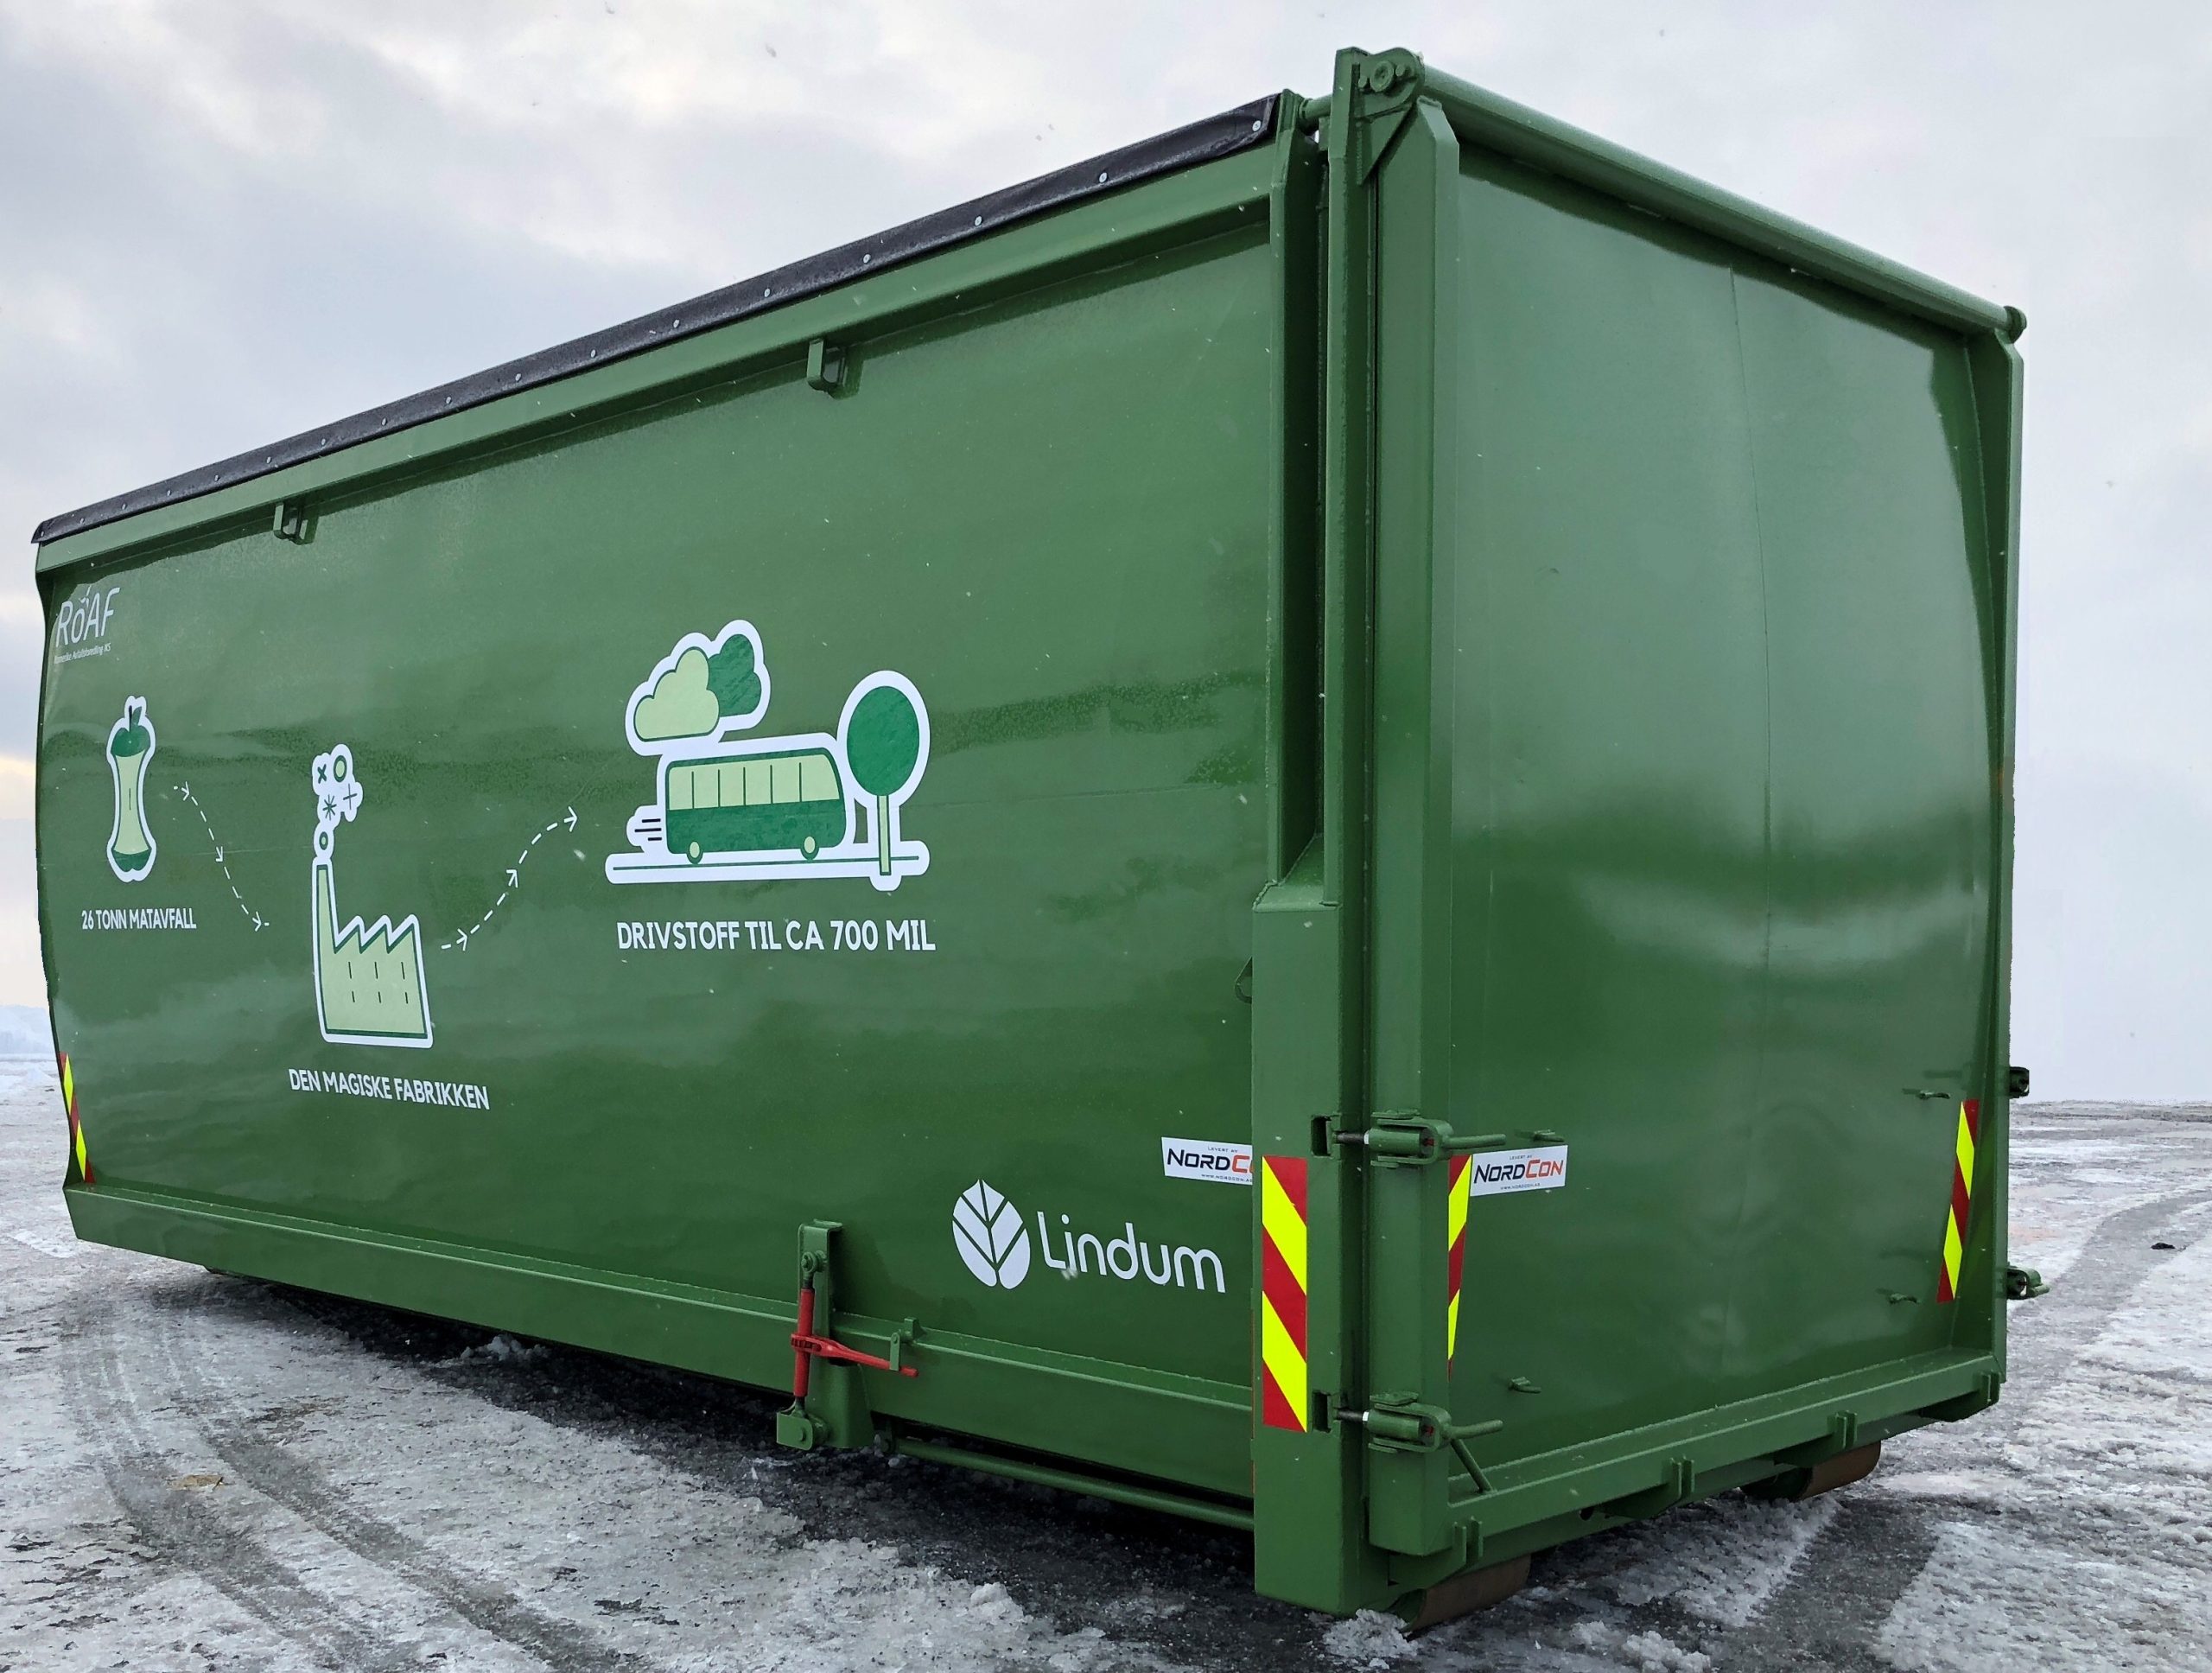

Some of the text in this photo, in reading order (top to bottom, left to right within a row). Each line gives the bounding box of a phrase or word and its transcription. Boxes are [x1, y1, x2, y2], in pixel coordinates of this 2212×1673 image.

[81, 907, 197, 930] 26 TONN MATAVFALL
[617, 919, 936, 951] DRIVSTOFF TIL CA 700 MIL
[289, 1068, 490, 1110] DEN MAGISKE FABRIKKEN
[1167, 1148, 1254, 1174] NORDC
[1037, 1211, 1226, 1294] Lindum
